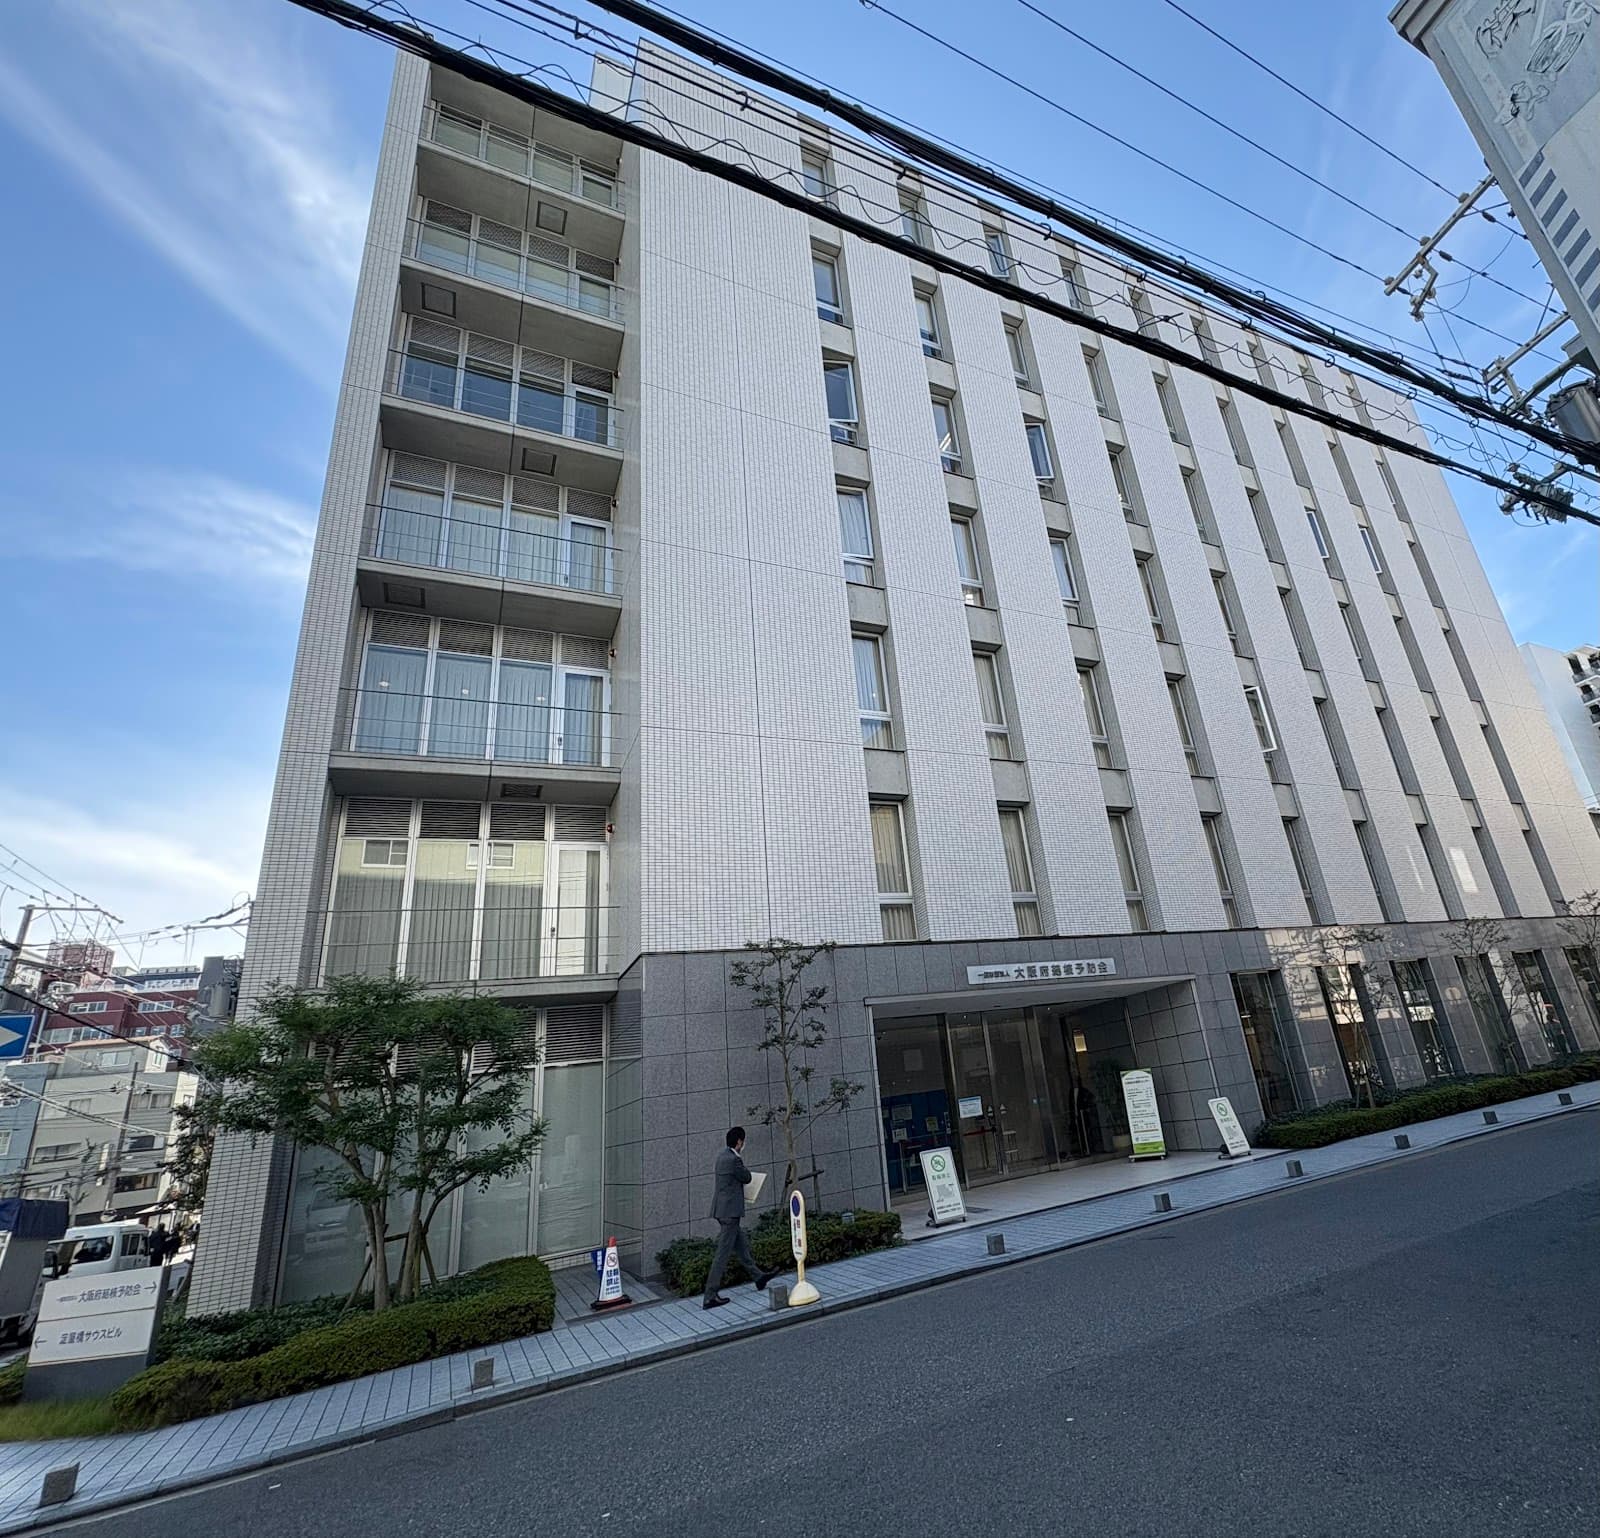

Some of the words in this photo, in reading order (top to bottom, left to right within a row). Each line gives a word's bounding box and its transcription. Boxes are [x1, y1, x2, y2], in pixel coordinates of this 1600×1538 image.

[1014, 962, 1108, 980] 大阪府結核予防会
[78, 1283, 142, 1303] 大阪府結核予防会
